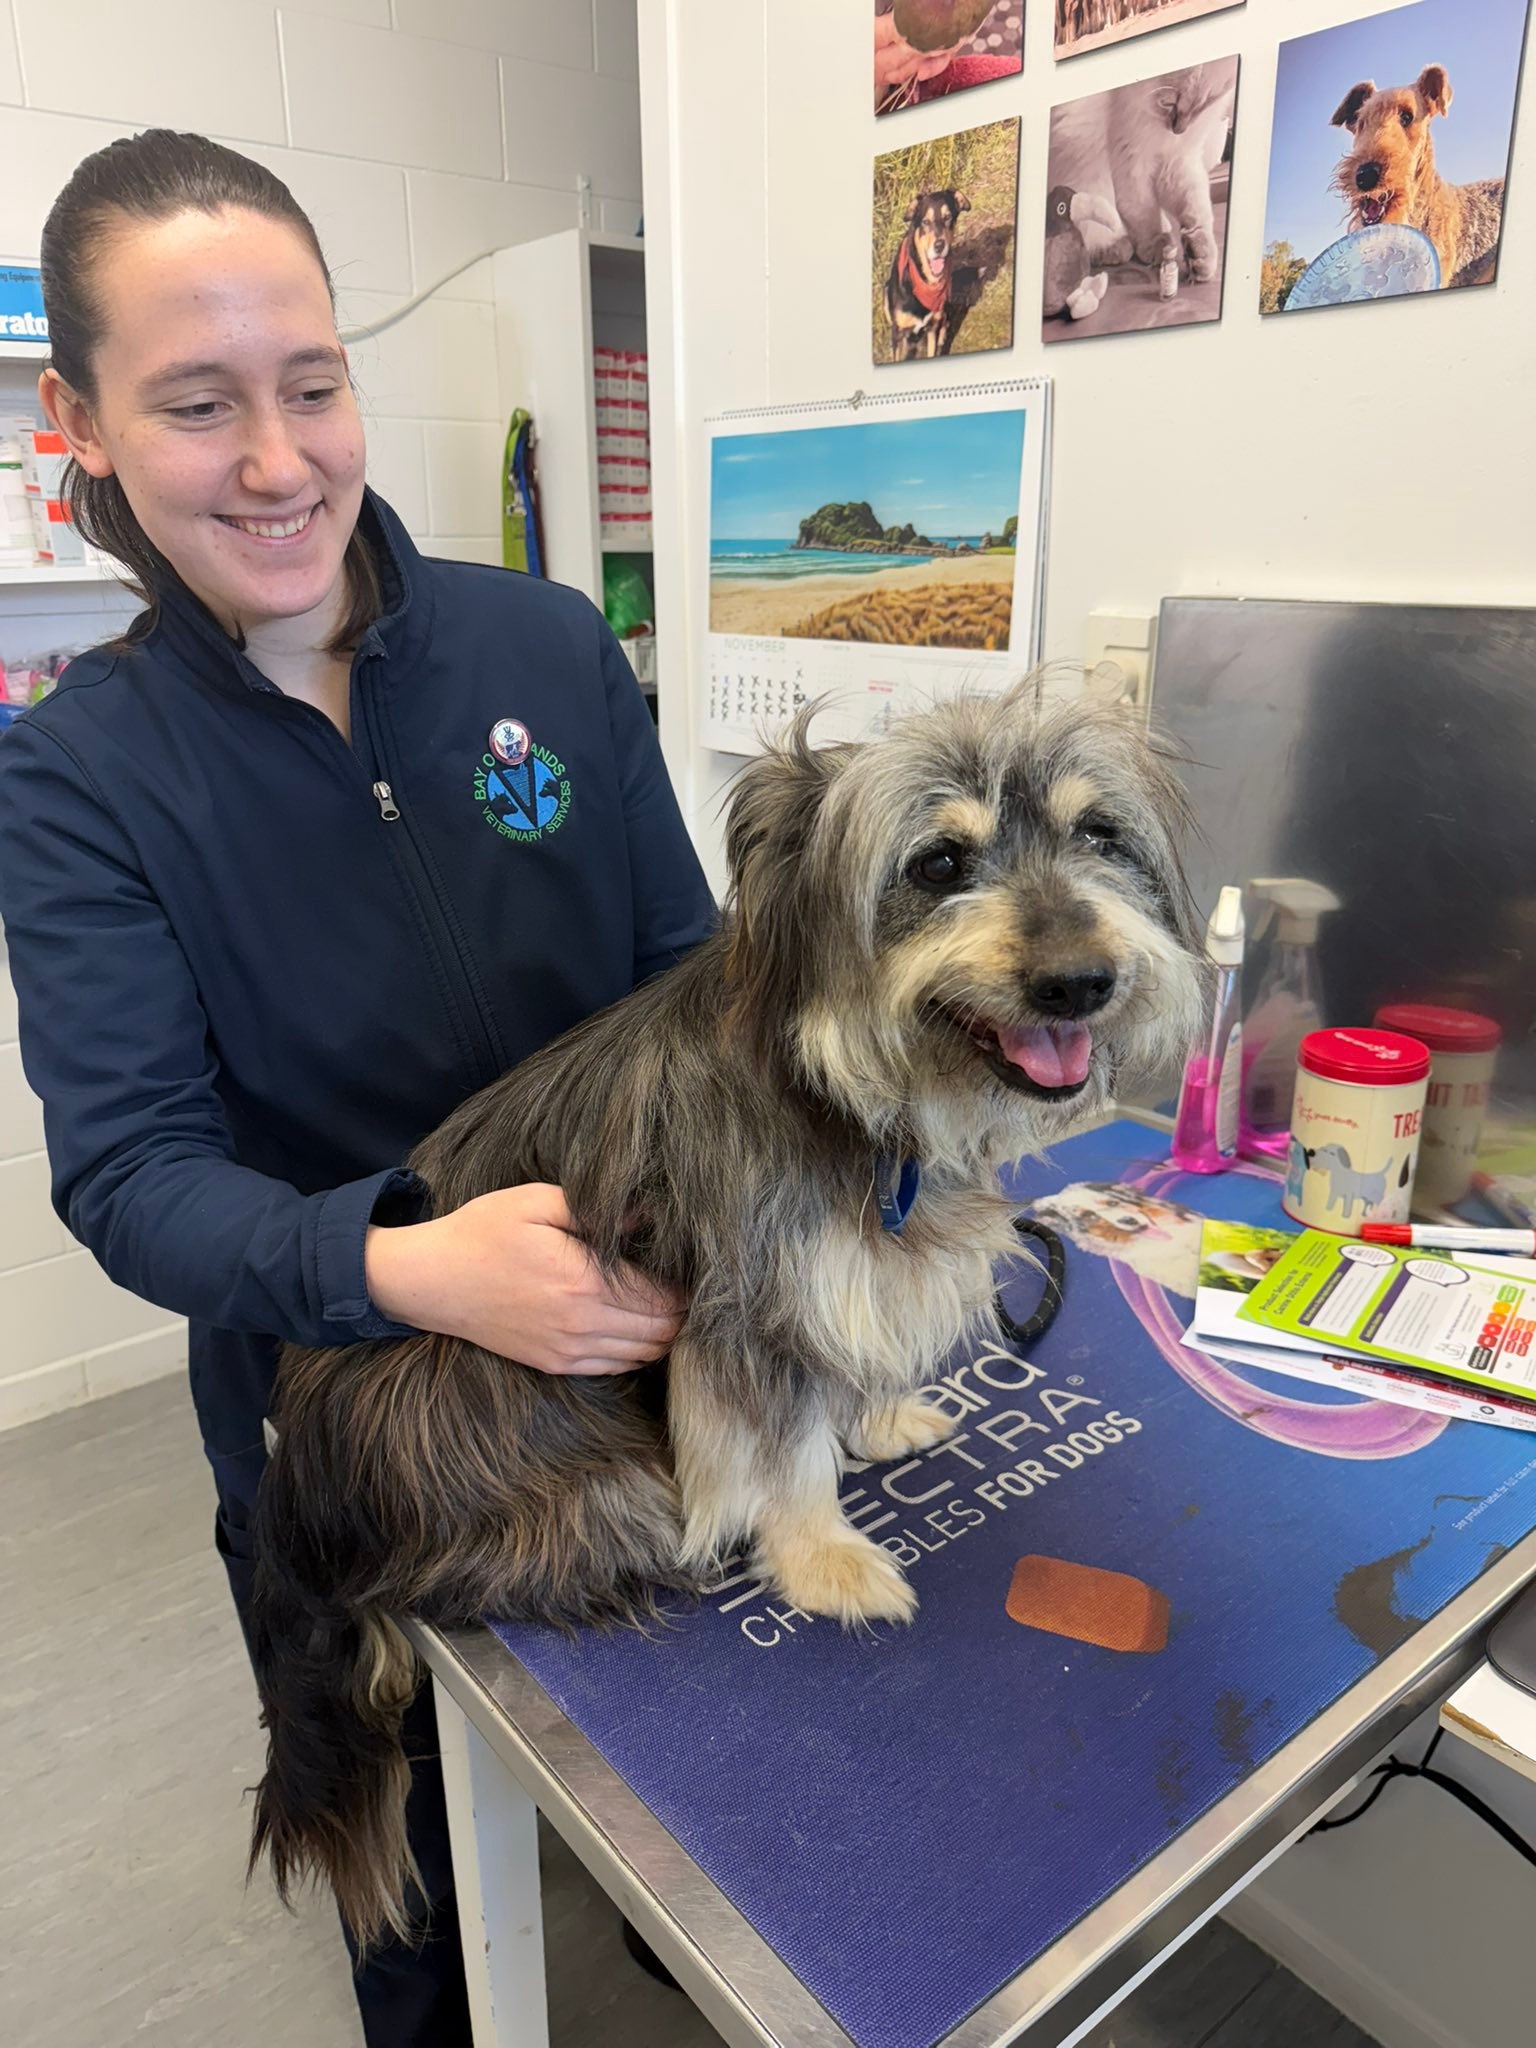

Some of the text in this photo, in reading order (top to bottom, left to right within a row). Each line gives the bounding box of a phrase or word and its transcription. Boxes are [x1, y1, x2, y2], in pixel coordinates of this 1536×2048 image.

[724, 638, 786, 651] NOVEMBER
[473, 766, 488, 801] BAY
[530, 743, 566, 777] ANDS
[481, 805, 543, 841] VETERINARY
[546, 780, 571, 833] SERVICES
[1393, 1109, 1425, 1139] TRE
[741, 1410, 1143, 1648] CHBLES FOR DOGS
